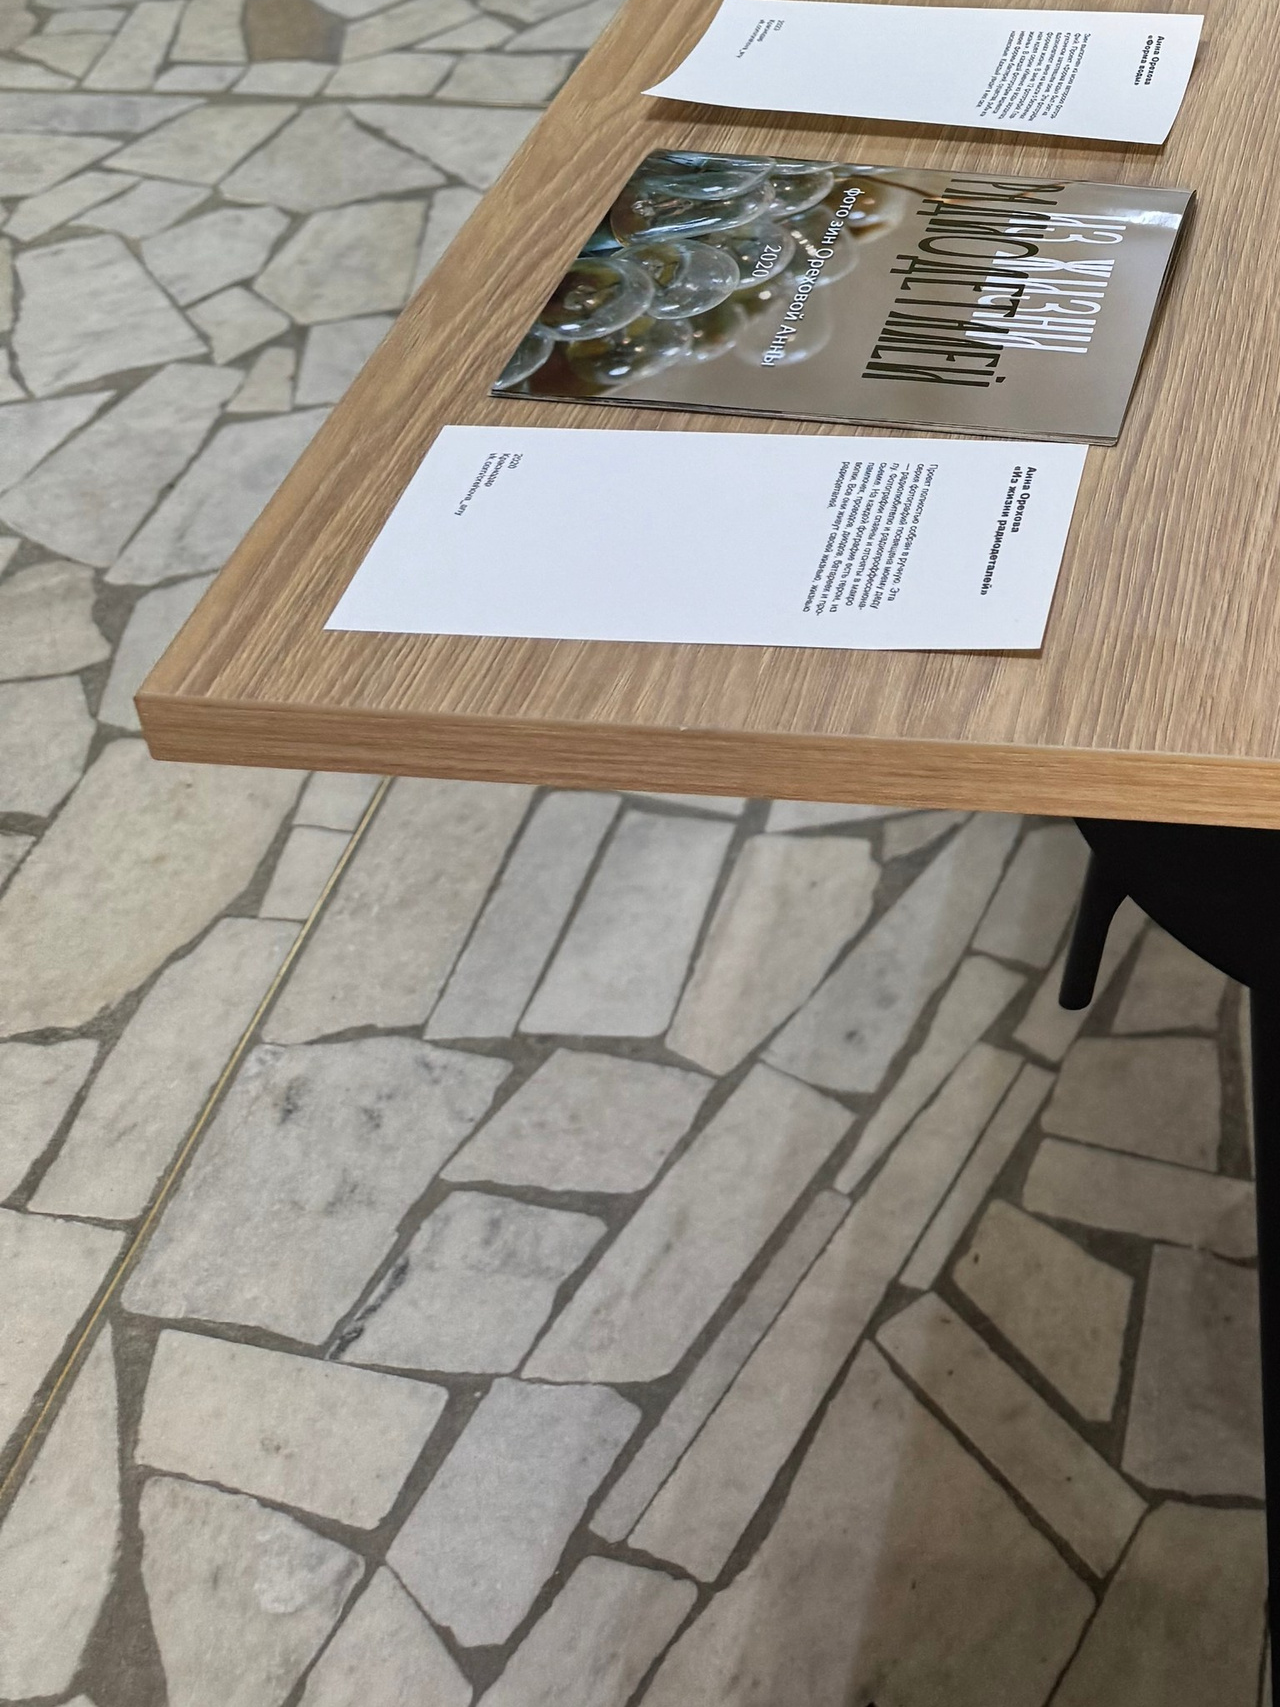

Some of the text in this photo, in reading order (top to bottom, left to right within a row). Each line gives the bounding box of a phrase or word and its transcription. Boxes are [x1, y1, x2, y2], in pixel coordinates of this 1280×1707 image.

[1143, 35, 1165, 85] Анна Орехова
[751, 245, 782, 278] 2020
[761, 187, 865, 366] фото зин Ореховой Анны
[861, 179, 1065, 387] РАДИОДЕТАЛЕЙ
[965, 251, 1115, 353] ЖИЗНИ
[843, 482, 857, 496] Все
[923, 463, 938, 487] Проект
[839, 496, 850, 510] они
[868, 488, 880, 498] На
[876, 472, 897, 513] Фотографии
[885, 471, 909, 525] радиолюбителю
[911, 487, 929, 524] полностью
[1010, 466, 1037, 532] Анна Орехова
[831, 510, 845, 531] живут
[844, 495, 863, 529] проводов,
[859, 498, 874, 524] каждой
[867, 514, 882, 540] спаяны
[869, 463, 924, 609] серия фотографий посвящена моему деду
[903, 525, 917, 550] собран
[980, 465, 1022, 595] «Из жизни радиодеталей»
[823, 531, 837, 553] своей
[833, 530, 851, 558] диодов,
[811, 553, 829, 582] жизнью,
[822, 559, 842, 592] батареек
[840, 562, 853, 578] есть
[855, 547, 871, 576] отсняты
[802, 584, 818, 612] жизнью
[815, 599, 826, 616] про-
[828, 603, 838, 612] из
[844, 583, 859, 606] макро
[886, 587, 900, 601] Эта
